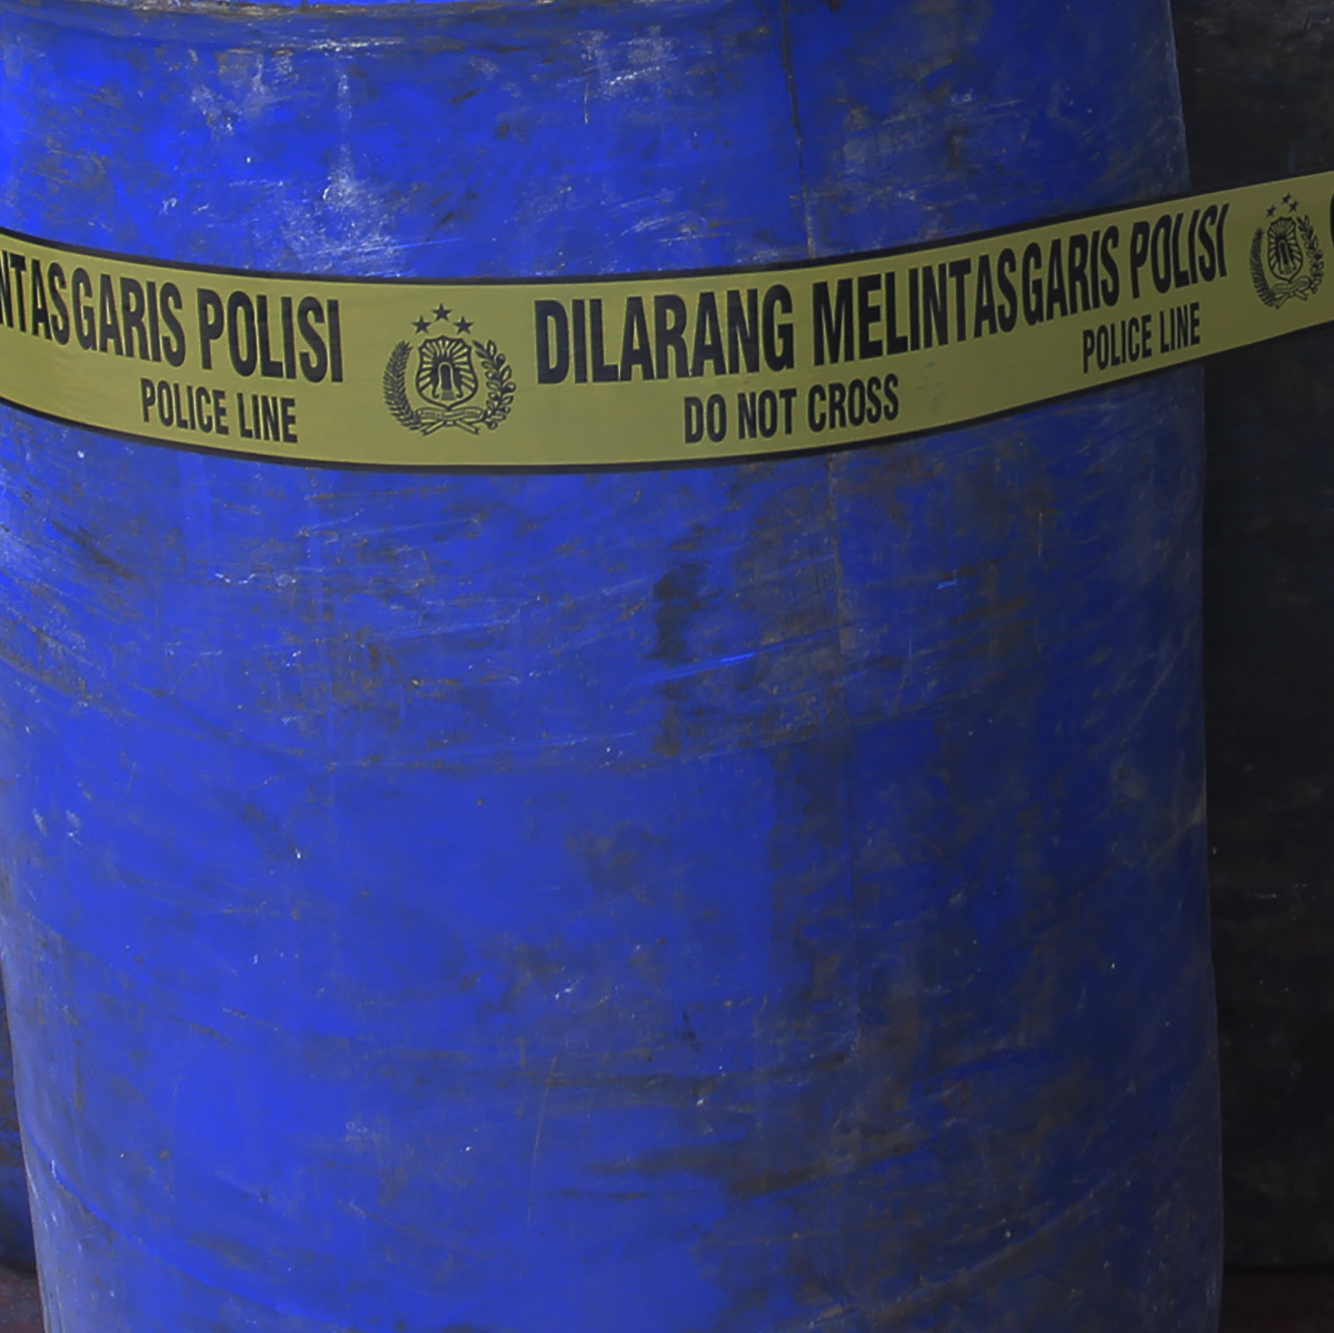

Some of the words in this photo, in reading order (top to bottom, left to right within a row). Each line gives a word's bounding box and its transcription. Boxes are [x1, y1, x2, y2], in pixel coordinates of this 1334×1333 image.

[534, 283, 795, 385] DILARANG
[1129, 202, 1231, 300] POLISI
[196, 287, 344, 384] POLISI
[1081, 313, 1153, 375] POLICE
[1159, 301, 1201, 354] LINE
[140, 377, 230, 436] POLICE
[237, 391, 298, 444] LINE
[683, 393, 727, 444] DO
[737, 388, 798, 440] NOT
[807, 373, 900, 433] CROSS
